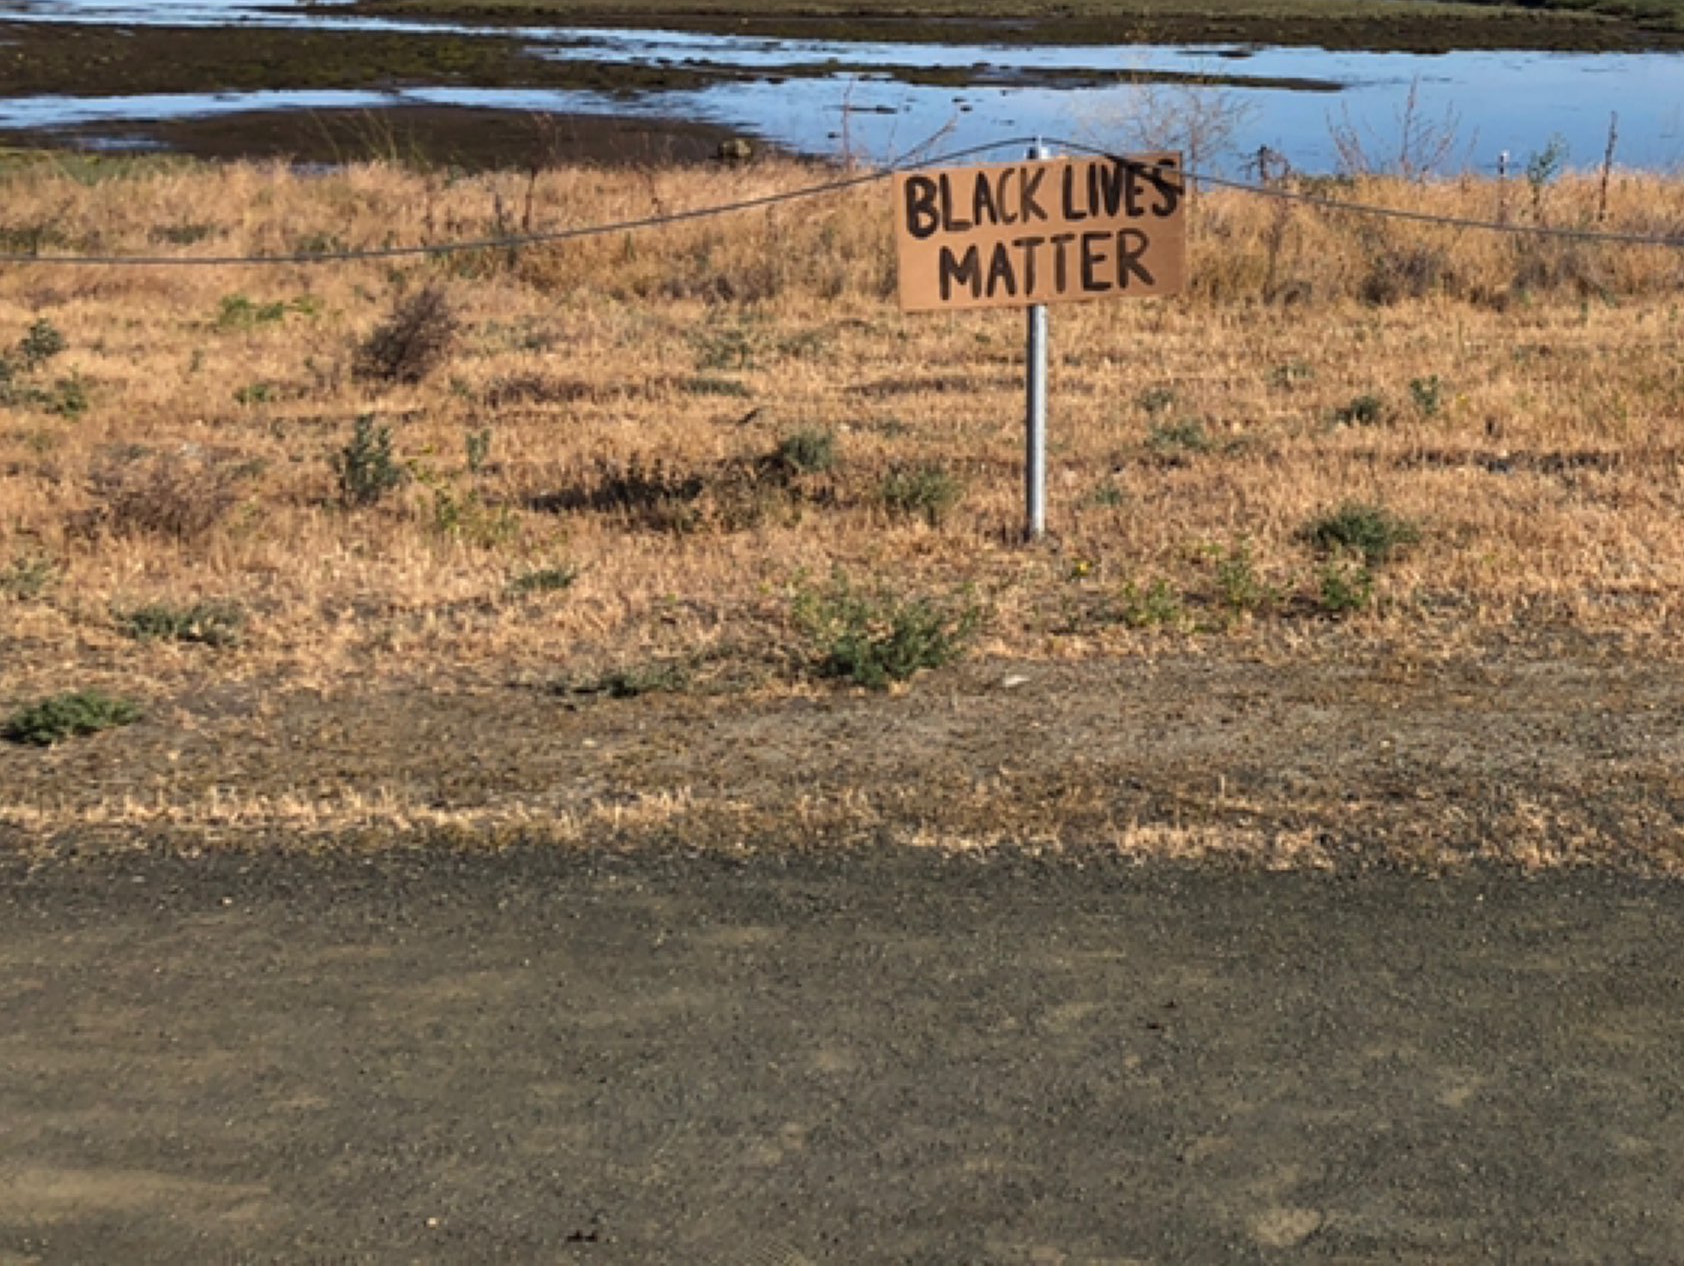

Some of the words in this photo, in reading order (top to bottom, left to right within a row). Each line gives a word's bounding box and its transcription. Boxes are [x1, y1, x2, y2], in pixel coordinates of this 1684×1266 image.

[904, 167, 1048, 238] BLACK
[1062, 158, 1181, 221] LIVES
[939, 228, 1155, 301] MATTER
